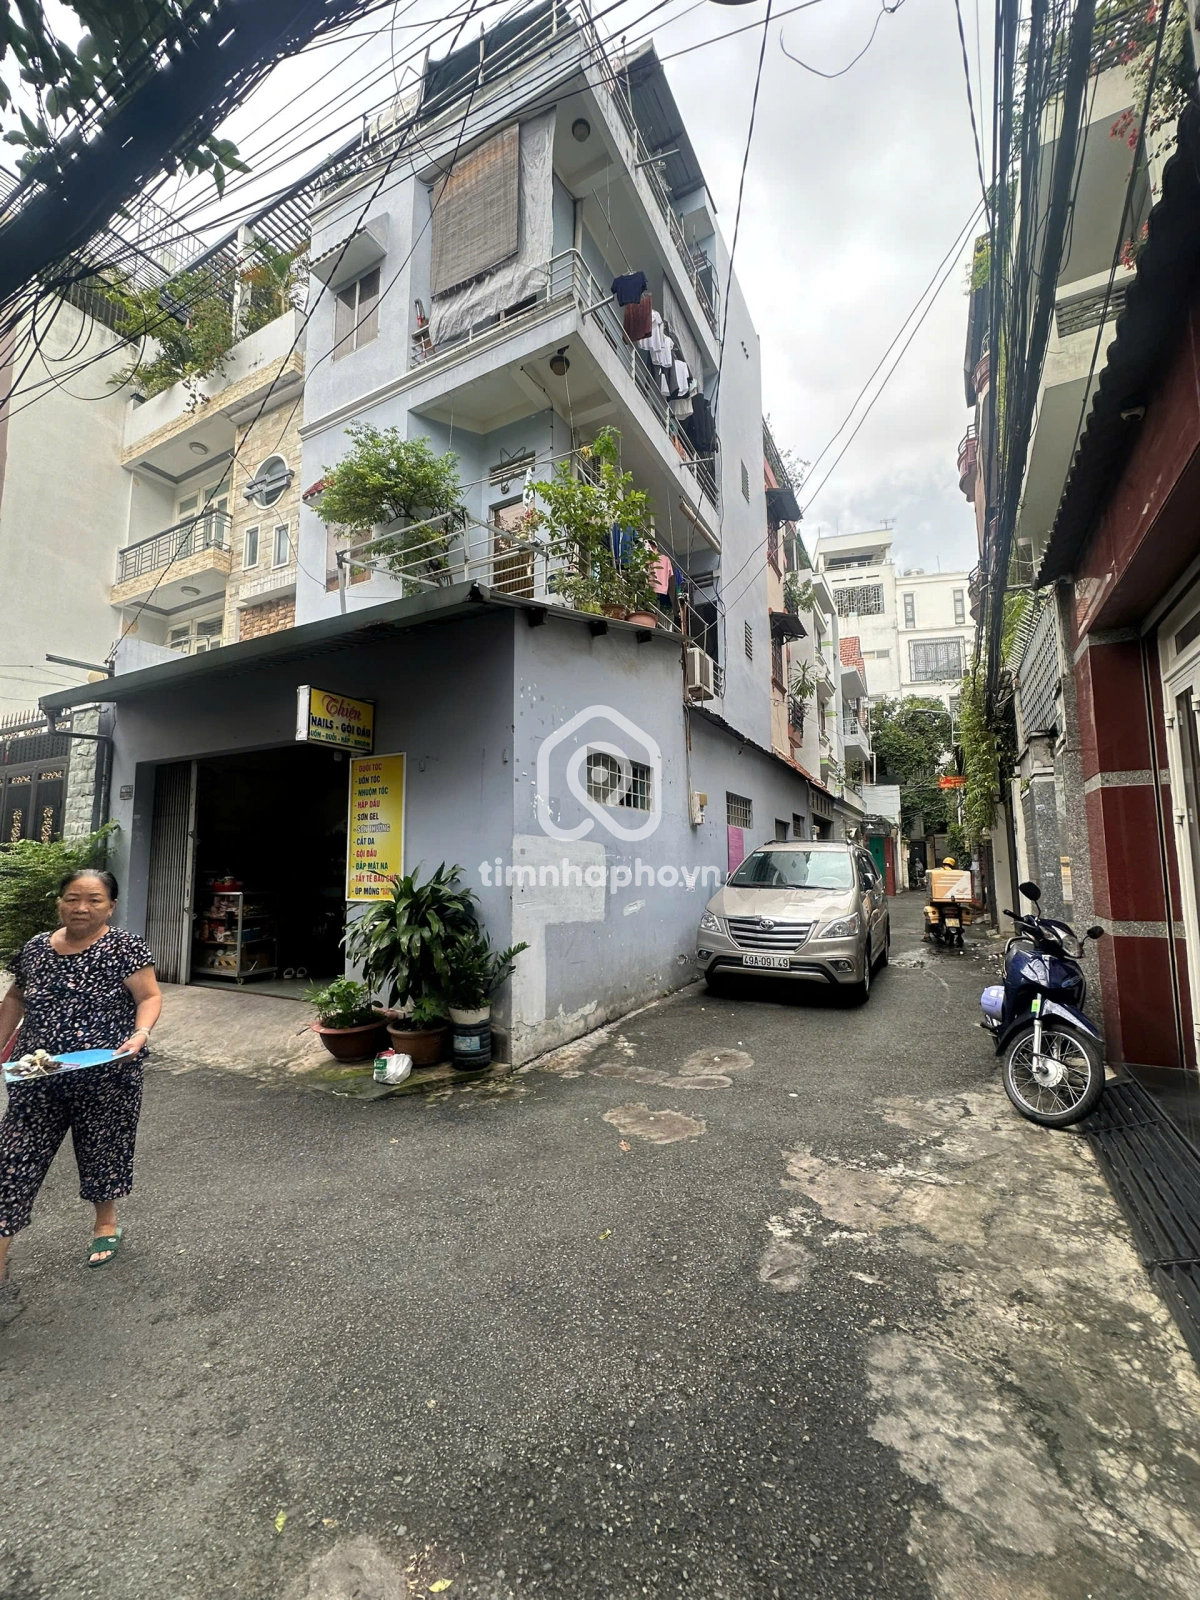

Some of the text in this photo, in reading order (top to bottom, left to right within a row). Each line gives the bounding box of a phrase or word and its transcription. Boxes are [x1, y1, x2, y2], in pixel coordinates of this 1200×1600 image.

[312, 716, 333, 729] NAILS
[379, 786, 388, 794] TÓC
[369, 812, 379, 820] GEL
[368, 837, 374, 845] DA
